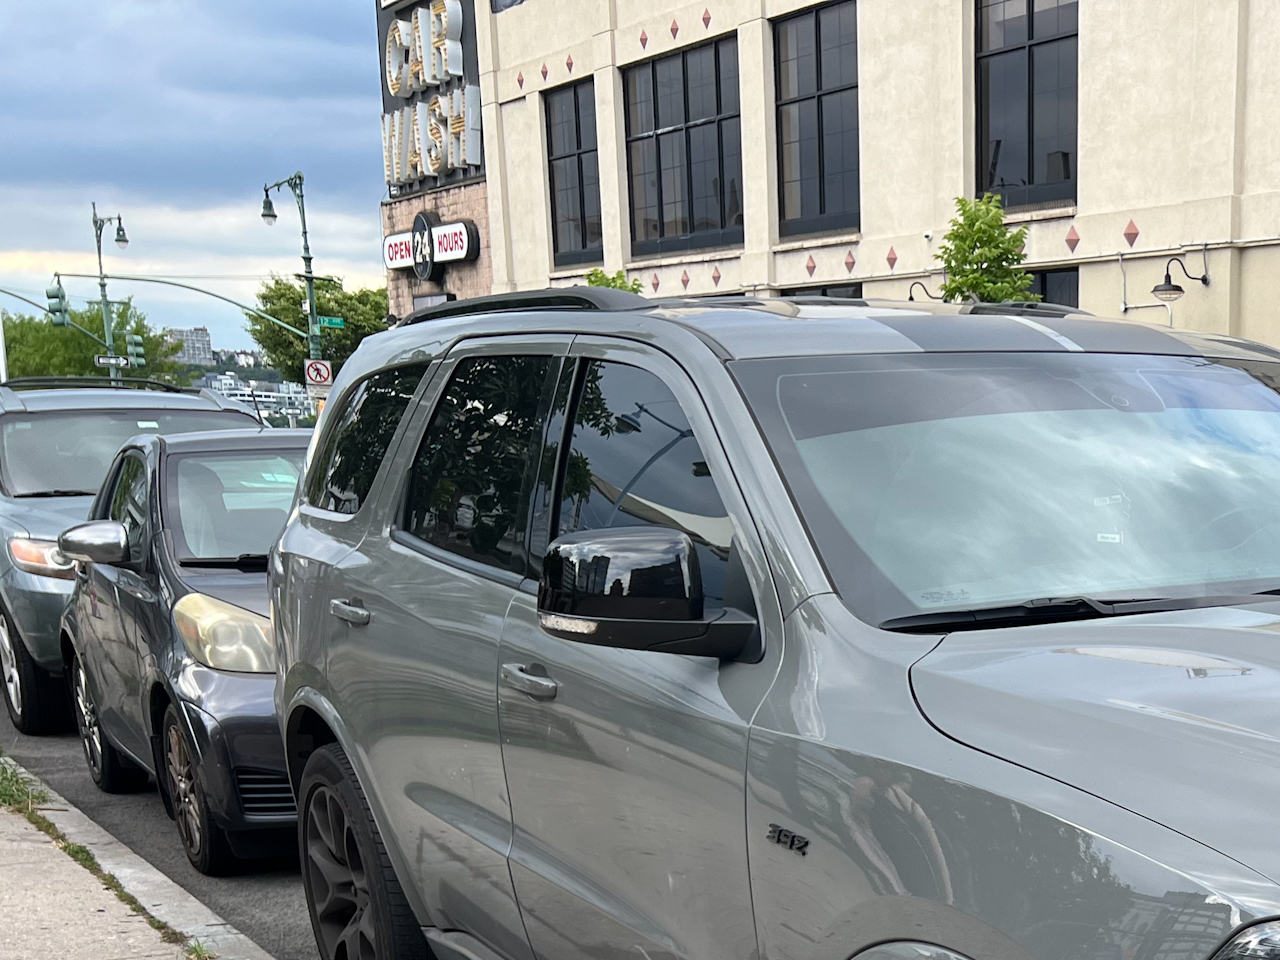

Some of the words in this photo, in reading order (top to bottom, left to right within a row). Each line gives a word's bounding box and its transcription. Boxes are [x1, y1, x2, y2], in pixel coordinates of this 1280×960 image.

[385, 0, 464, 97] CAR
[381, 84, 482, 186] WASH
[388, 240, 411, 262] OPEN
[413, 230, 431, 264] 24
[437, 229, 464, 254] HOURS
[320, 317, 329, 325] 12
[766, 823, 810, 856] 392
